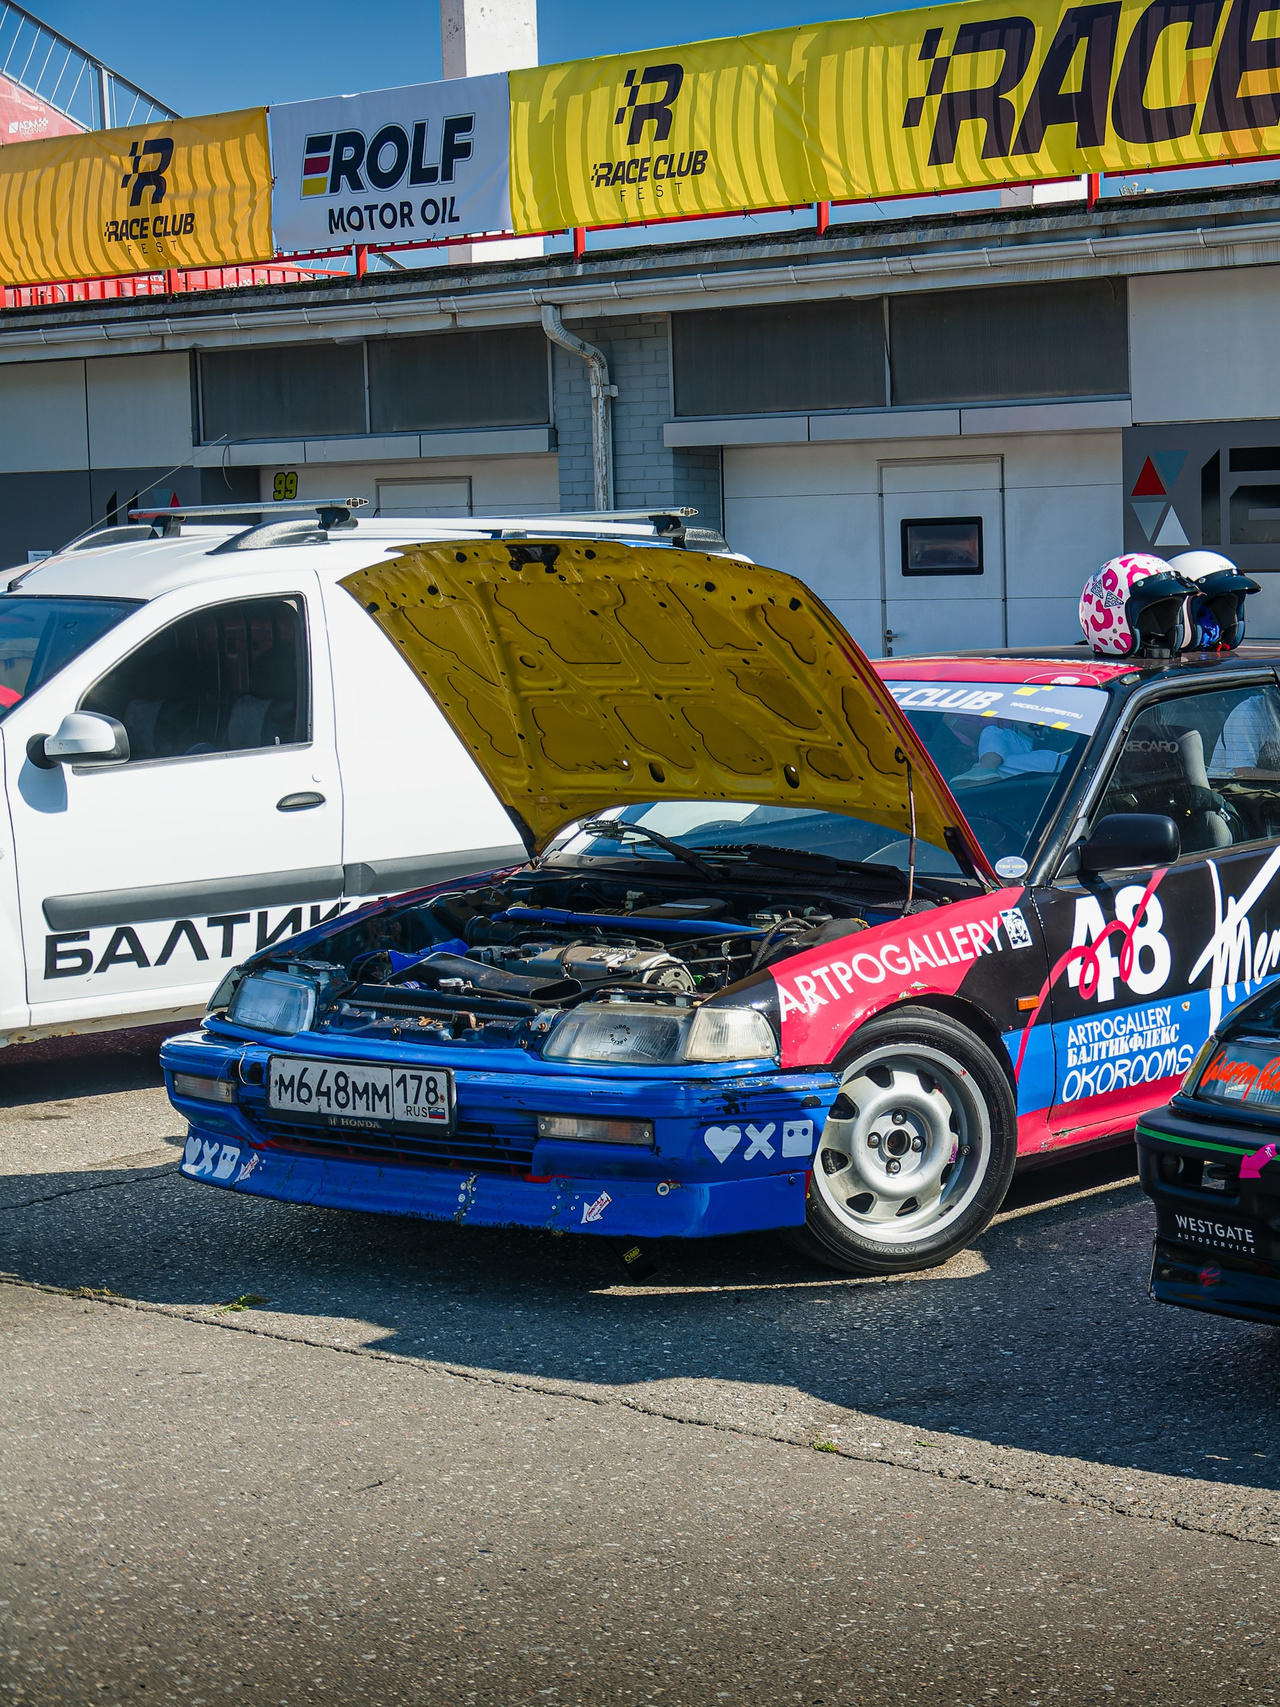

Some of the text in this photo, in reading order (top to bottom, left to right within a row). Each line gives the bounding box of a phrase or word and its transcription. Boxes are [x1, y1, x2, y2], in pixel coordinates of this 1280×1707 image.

[18, 120, 40, 131] ADM
[300, 112, 476, 199] ROLF
[591, 150, 708, 188] RACE CLUB
[620, 182, 683, 202] FEST
[104, 213, 195, 242] RACE CLUB
[328, 196, 460, 234] MOTOR OIL
[127, 240, 177, 256] FEST
[272, 471, 299, 501] 99
[911, 688, 1004, 711] CLUB
[1067, 885, 1171, 1002] 48
[777, 917, 1003, 1022] ARTPOGALLERY
[1067, 1005, 1171, 1047] ARTPOGALLERY
[1067, 1023, 1180, 1068] БАЛТИКФЛЕКС
[1062, 1044, 1194, 1102] OKOROOMS
[395, 1074, 439, 1106] 178
[341, 1118, 382, 1129] HONDA
[406, 1105, 428, 1118] RUS
[1175, 1214, 1254, 1244] WESTGATE
[1177, 1232, 1257, 1254] AUTOSERVICE
[624, 1247, 640, 1262] OMP
